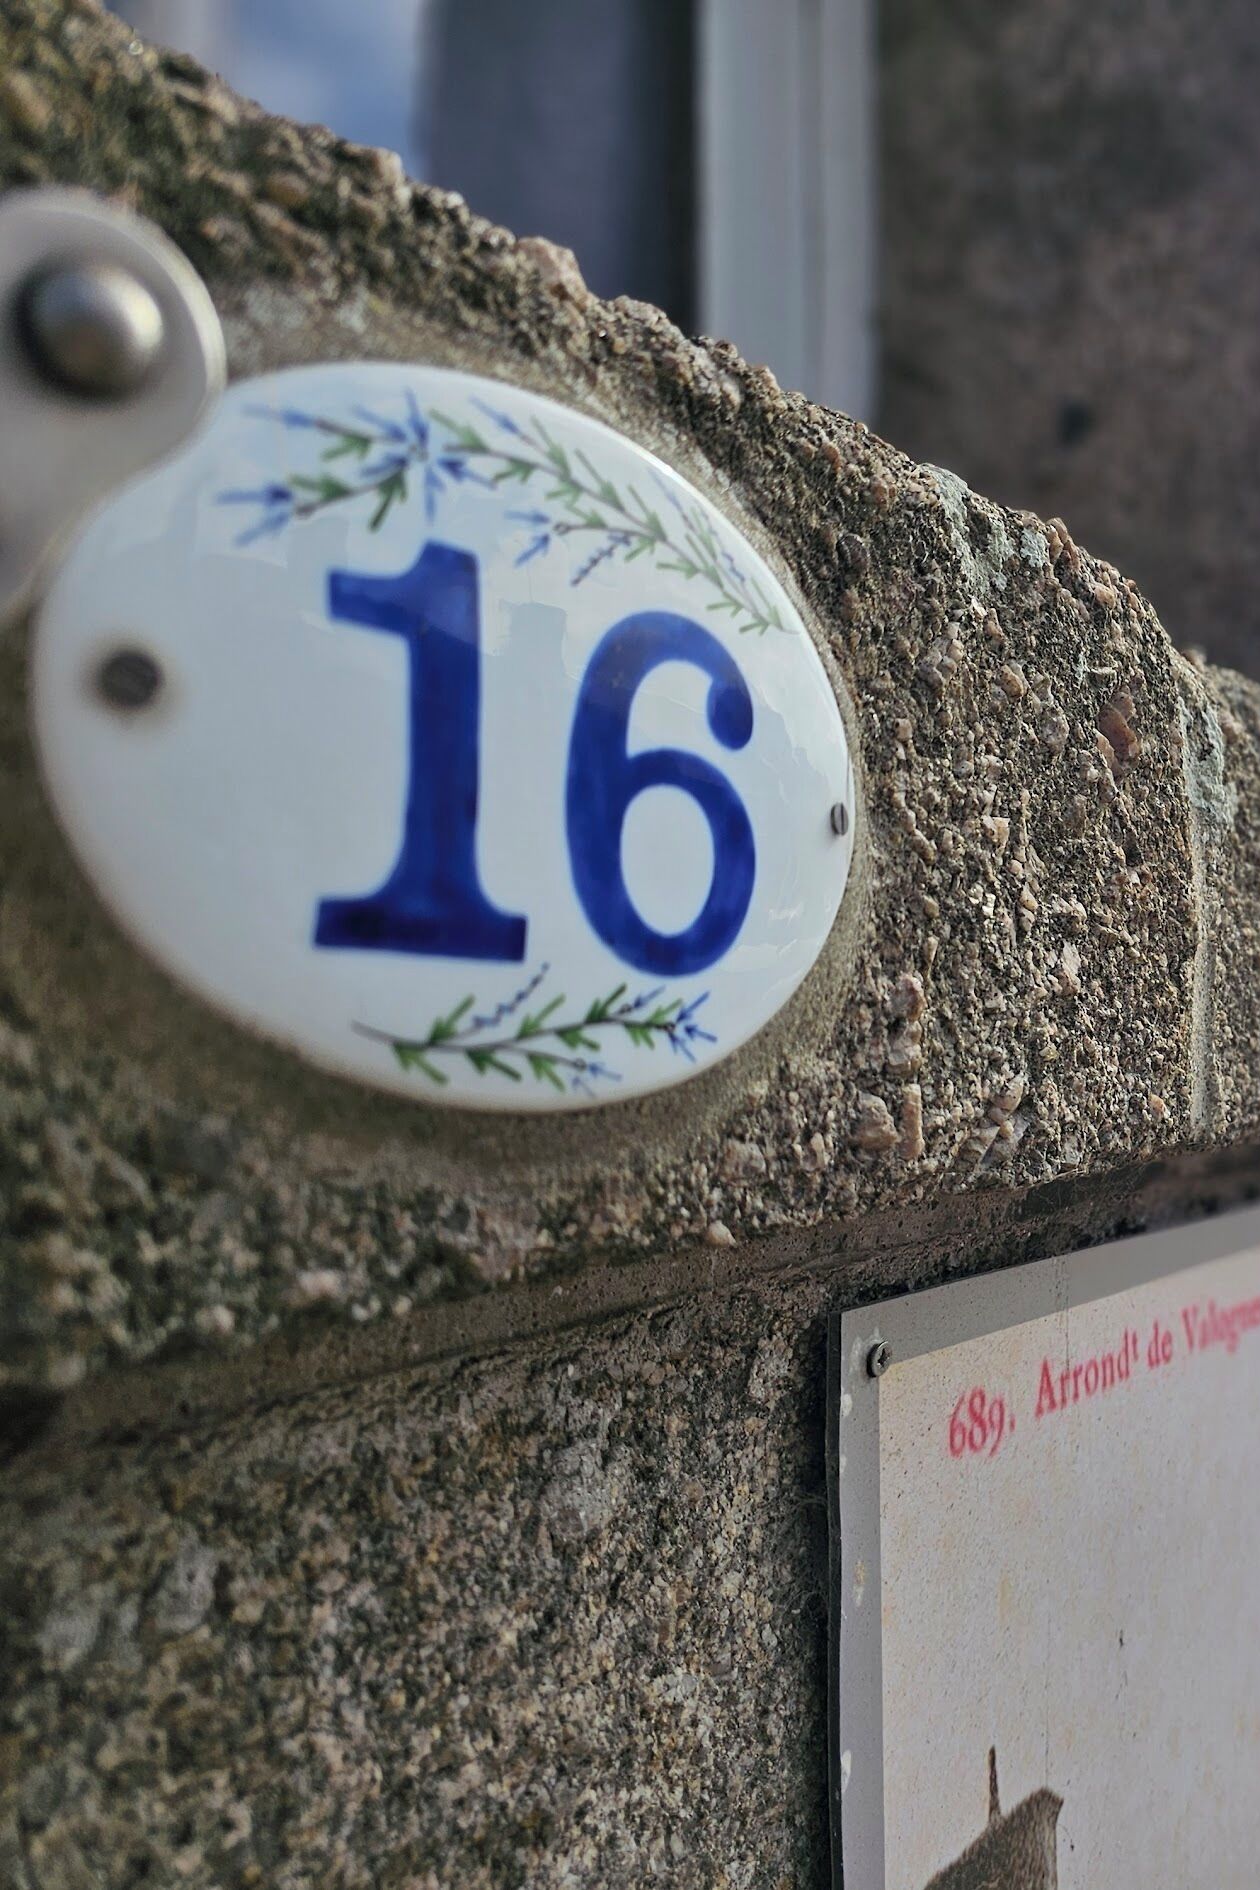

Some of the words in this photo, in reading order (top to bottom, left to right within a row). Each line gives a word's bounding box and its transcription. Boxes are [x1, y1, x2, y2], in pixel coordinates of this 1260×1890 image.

[312, 539, 757, 977] 16
[946, 1386, 1016, 1459] 689.
[1146, 1319, 1173, 1369] de
